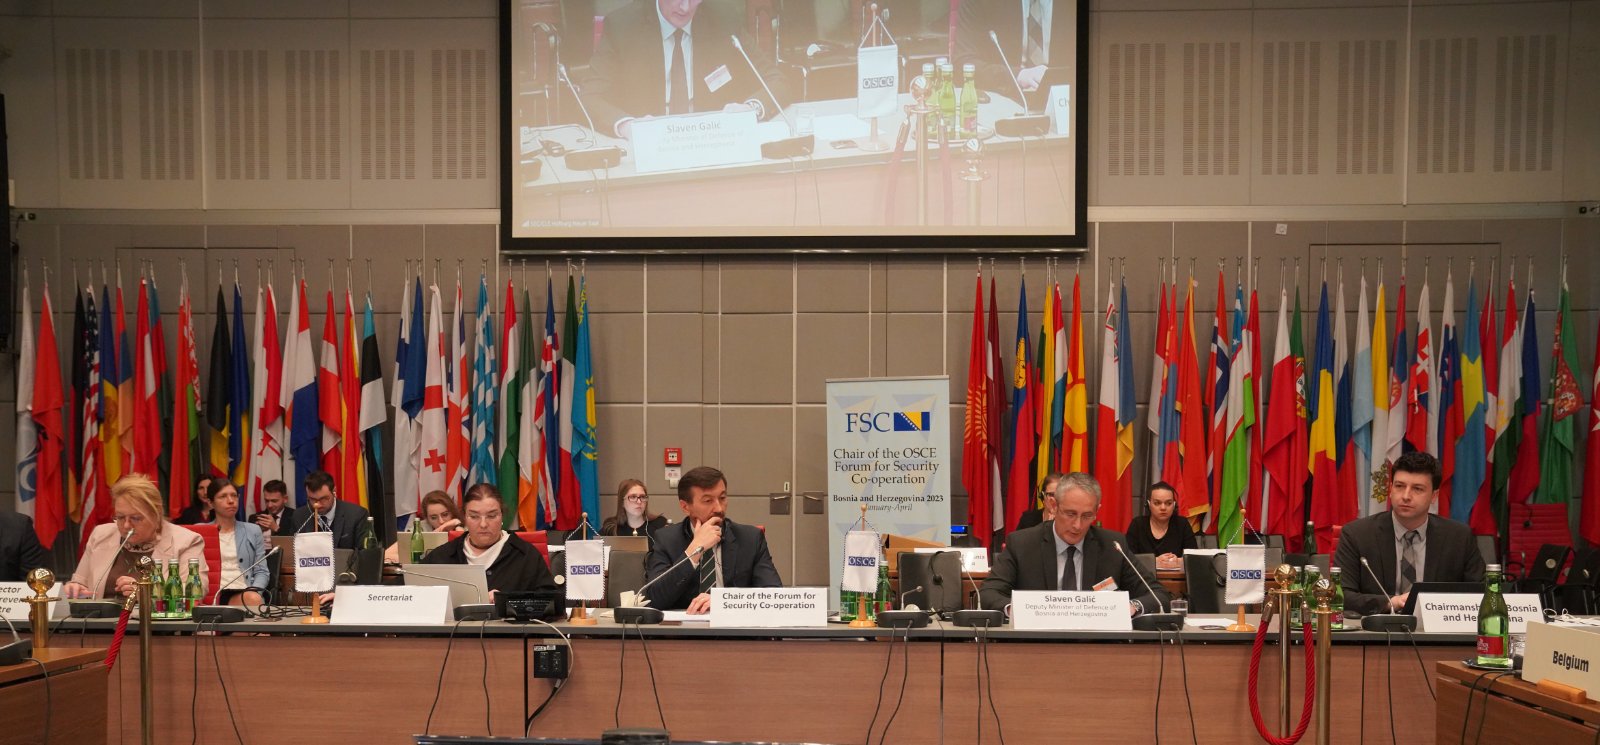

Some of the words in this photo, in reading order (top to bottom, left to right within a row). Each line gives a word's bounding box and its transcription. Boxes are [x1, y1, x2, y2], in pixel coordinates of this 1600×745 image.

[845, 411, 890, 433] FSC
[833, 448, 865, 459] Chair
[867, 447, 880, 459] of
[882, 448, 900, 459] the
[903, 447, 937, 459] OSCE
[834, 461, 871, 472] Forum
[874, 460, 891, 472] for
[893, 460, 940, 475] Security
[851, 473, 926, 487] Co-operation
[833, 494, 858, 502] Bosnia
[859, 494, 874, 502] and
[876, 494, 925, 504] Herzegovina
[926, 494, 944, 503] 2023
[866, 503, 913, 513] anuary-April
[367, 593, 414, 602] Secretariat
[723, 602, 757, 610] Security
[760, 602, 815, 610] Co-operation
[1425, 602, 1480, 611] Chairmansh
[1443, 613, 1461, 622] and
[1552, 650, 1589, 673] Belgium
